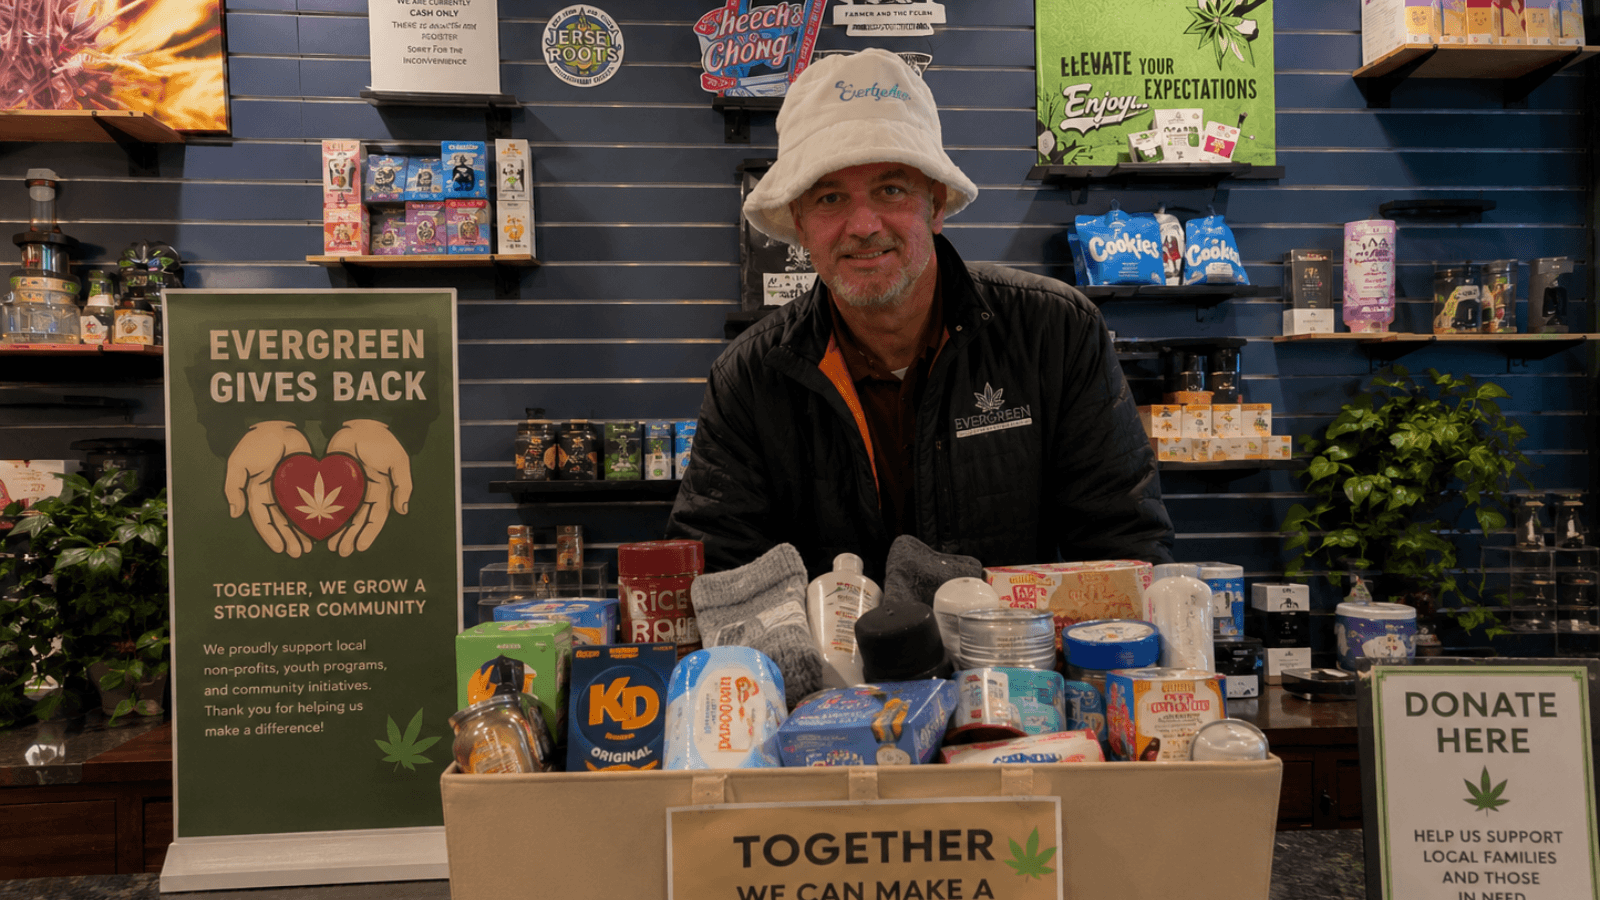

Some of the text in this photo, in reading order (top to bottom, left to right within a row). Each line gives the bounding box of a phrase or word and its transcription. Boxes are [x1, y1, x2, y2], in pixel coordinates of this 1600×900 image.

[409, 9, 460, 17] CASH ONLY
[545, 28, 620, 47] JERSEY
[545, 45, 620, 64] ROOTS
[1138, 57, 1175, 76] YOUR
[1144, 78, 1258, 101] EXPECTATIONS
[1088, 230, 1160, 263] Cookies
[209, 328, 425, 361] EVERGREEN
[210, 370, 428, 403] GIVES BACK
[954, 404, 1031, 430] EVERGREEN
[212, 578, 427, 599] TOGETHER, WE GROW A
[213, 599, 427, 620] STRONGER COMMUNITY
[630, 589, 688, 612] RICE
[203, 638, 367, 658] We proudly support local
[203, 660, 388, 678] non-profits, youth programs,
[203, 678, 372, 697] and community initiatives.
[204, 700, 364, 719] Thank you for helping us
[588, 676, 660, 730] KD
[1405, 691, 1558, 718] DONATE
[204, 720, 325, 738] make a difference!
[1437, 727, 1531, 754] HERE
[590, 746, 653, 763] ORIGINAL
[1414, 829, 1563, 844] HELP US SUPPORT
[733, 829, 996, 869] TOGETHER
[1423, 850, 1557, 865] LOCAL FAMILIES
[1442, 871, 1541, 885] AND THOSE
[736, 878, 995, 900] WE CAN MAKE A
[1481, 892, 1527, 900] NEED
